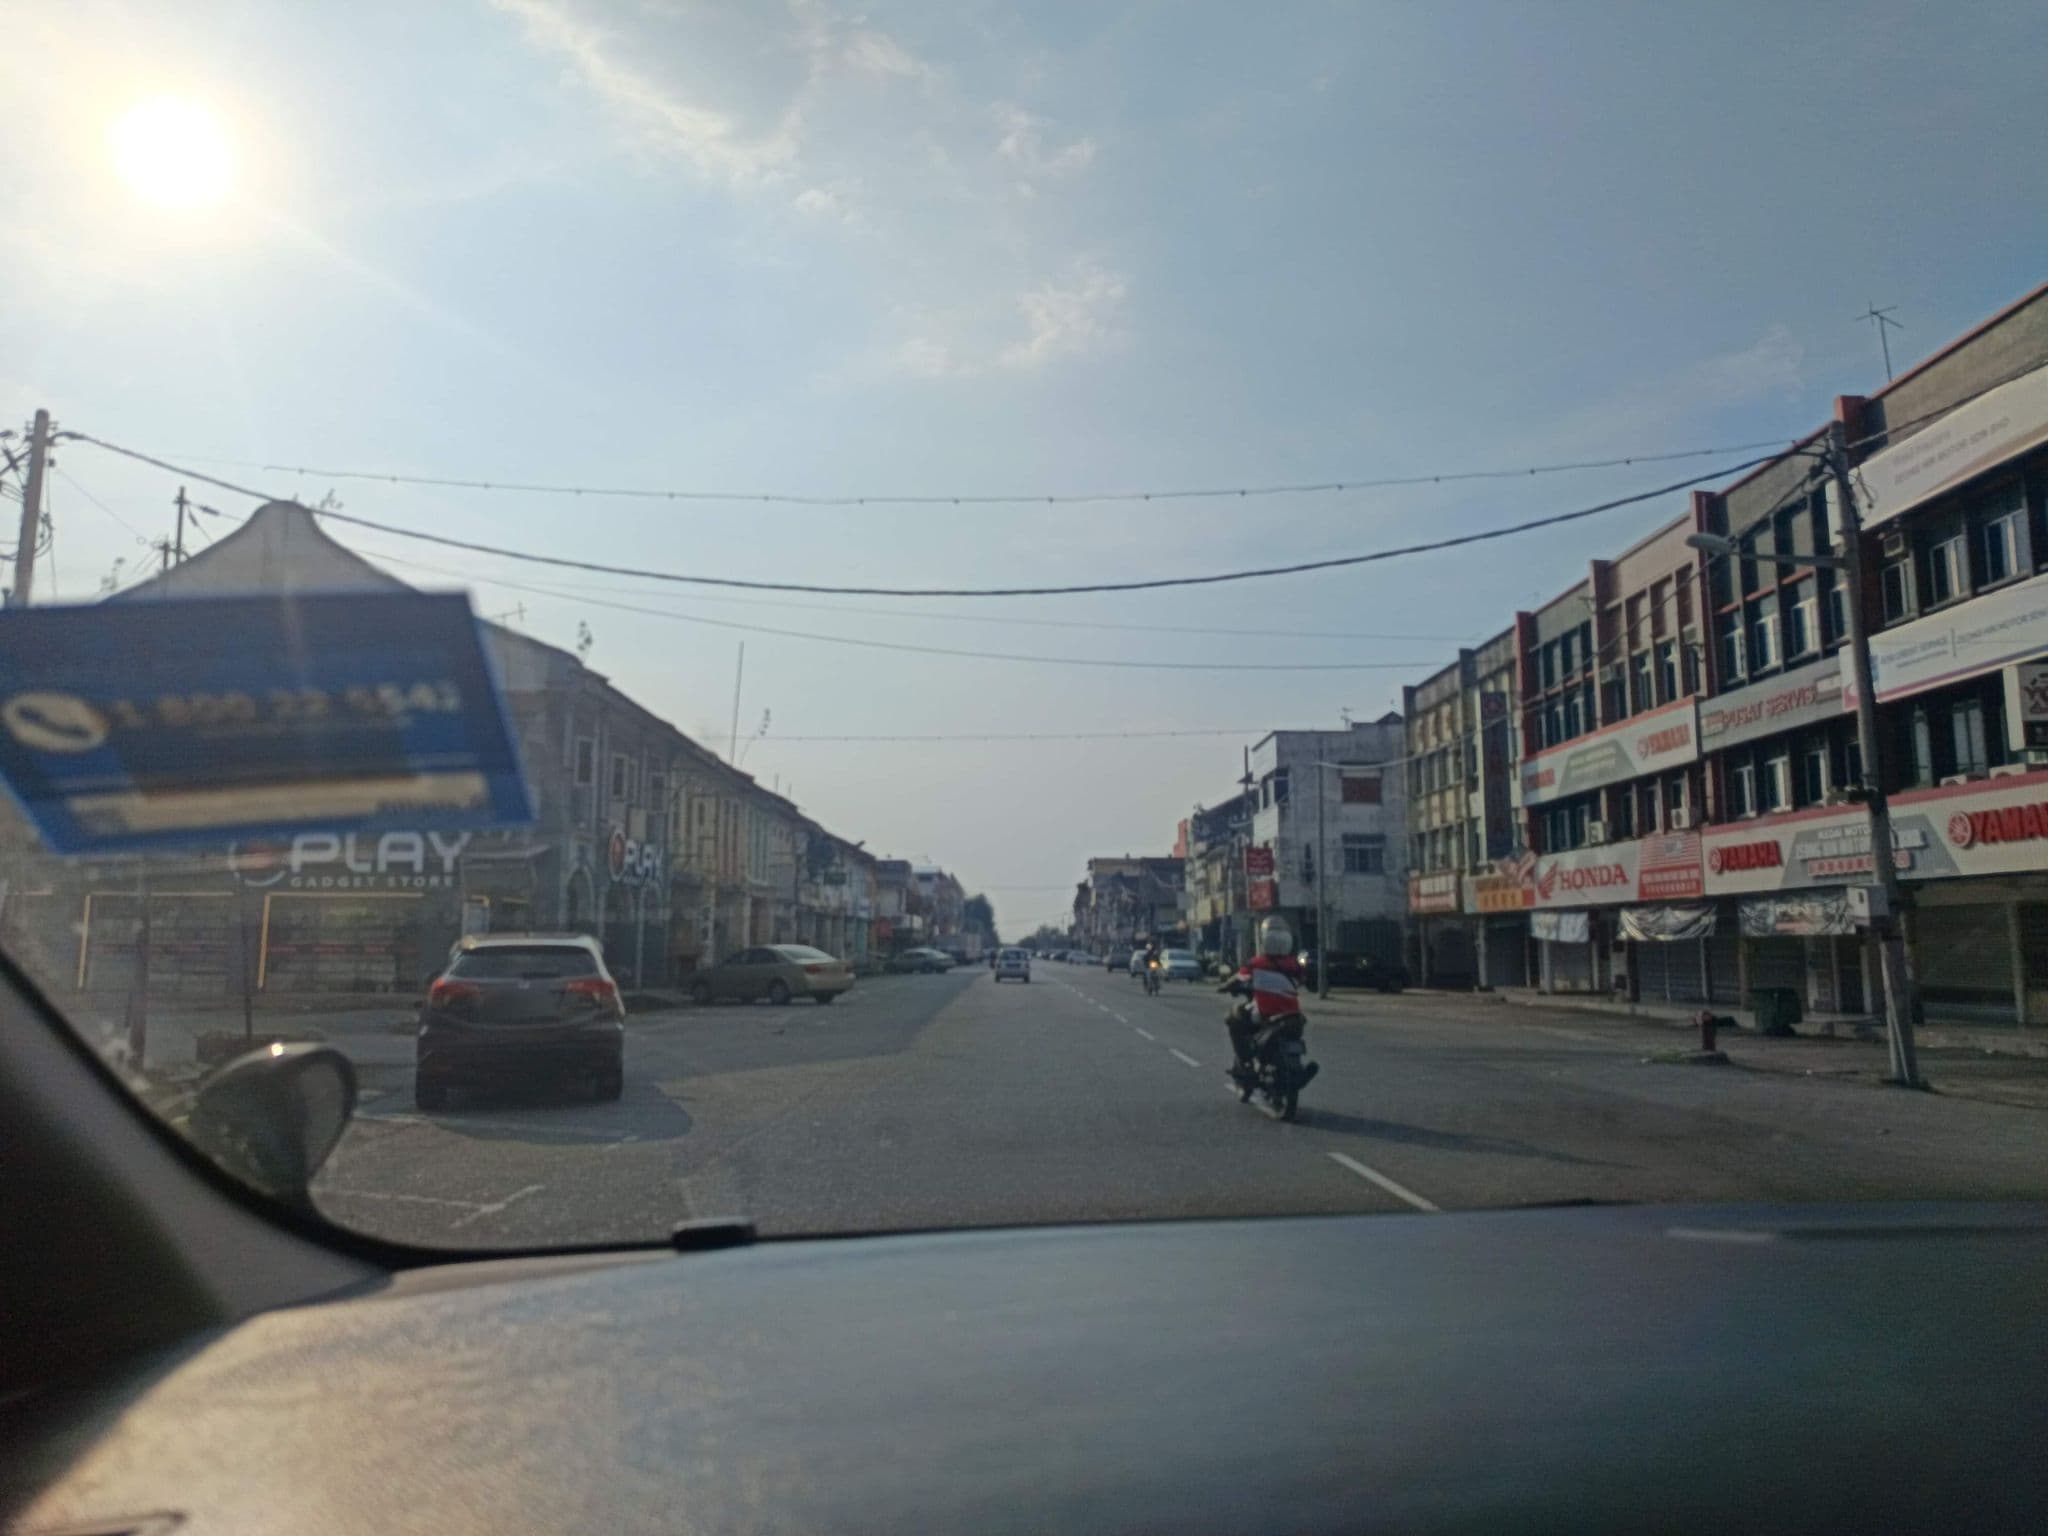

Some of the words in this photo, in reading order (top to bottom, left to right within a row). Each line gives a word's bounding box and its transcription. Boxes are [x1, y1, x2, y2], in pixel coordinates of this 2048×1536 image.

[290, 832, 473, 873] PLAY
[1720, 839, 1783, 872] YAMAHA
[289, 876, 378, 888] GADGET
[387, 875, 455, 888] STORE
[1558, 863, 1630, 890] HONDA
